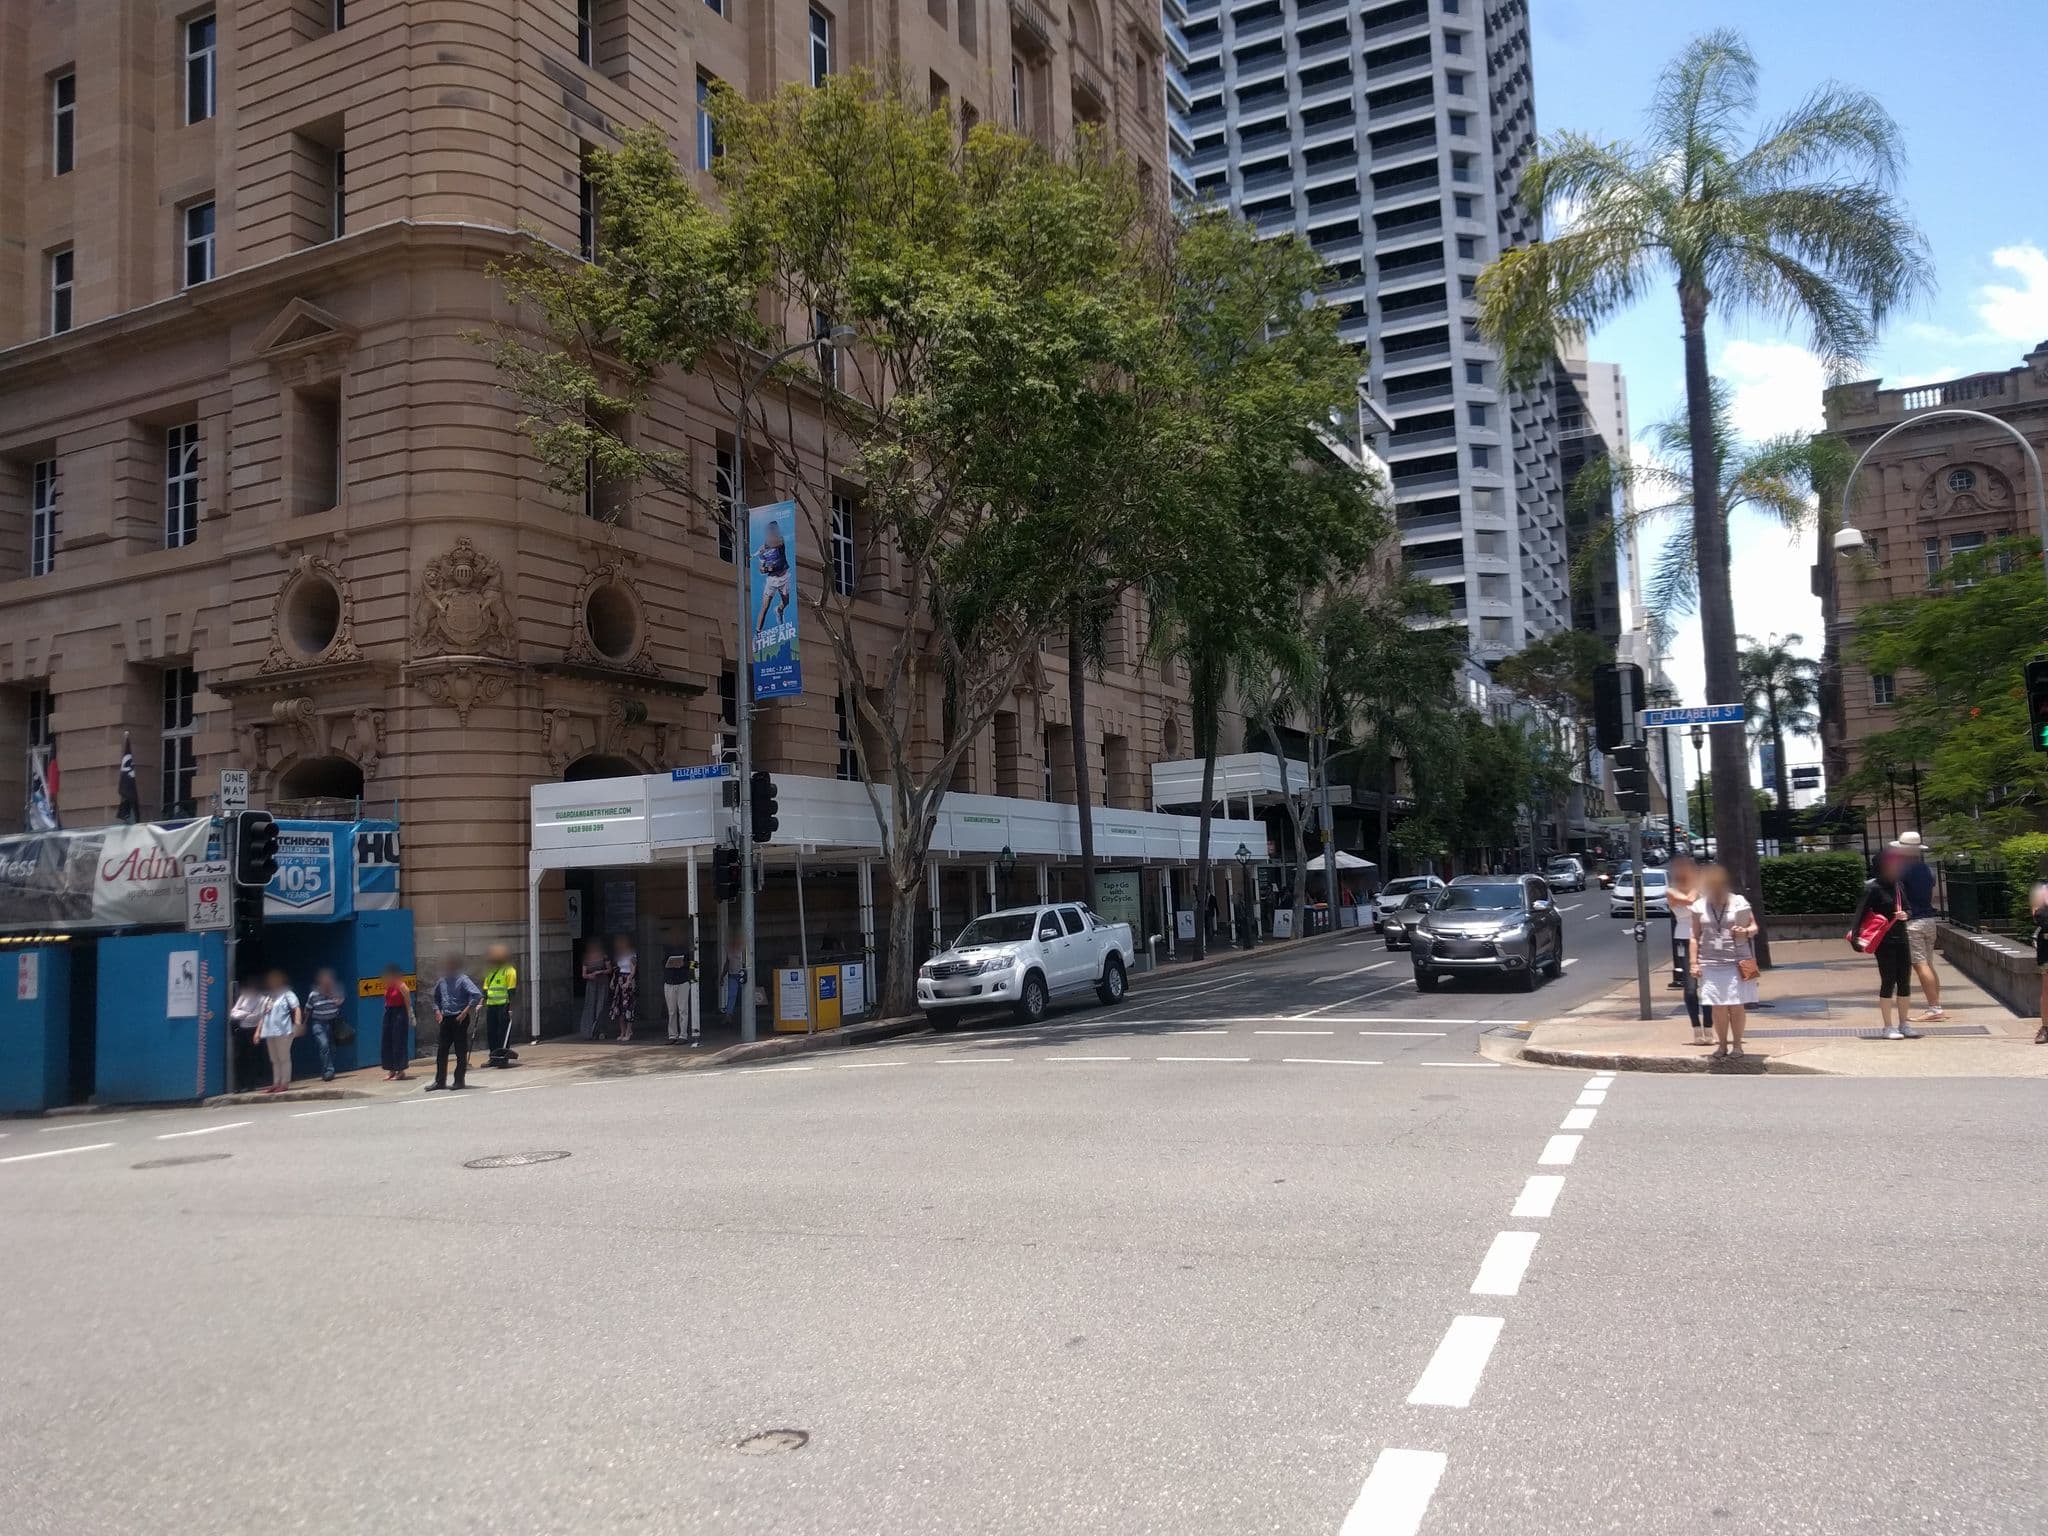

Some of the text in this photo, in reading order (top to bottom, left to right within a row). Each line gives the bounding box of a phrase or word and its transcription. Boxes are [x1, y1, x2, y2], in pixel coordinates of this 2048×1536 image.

[756, 626, 797, 651] THE AIR
[1663, 706, 1736, 720] ELIZABETH ST
[224, 773, 244, 783] ONE
[676, 766, 710, 778] ELIZABETH
[223, 786, 246, 796] WAY
[279, 864, 322, 892] 105
[286, 891, 311, 899] YEARS
